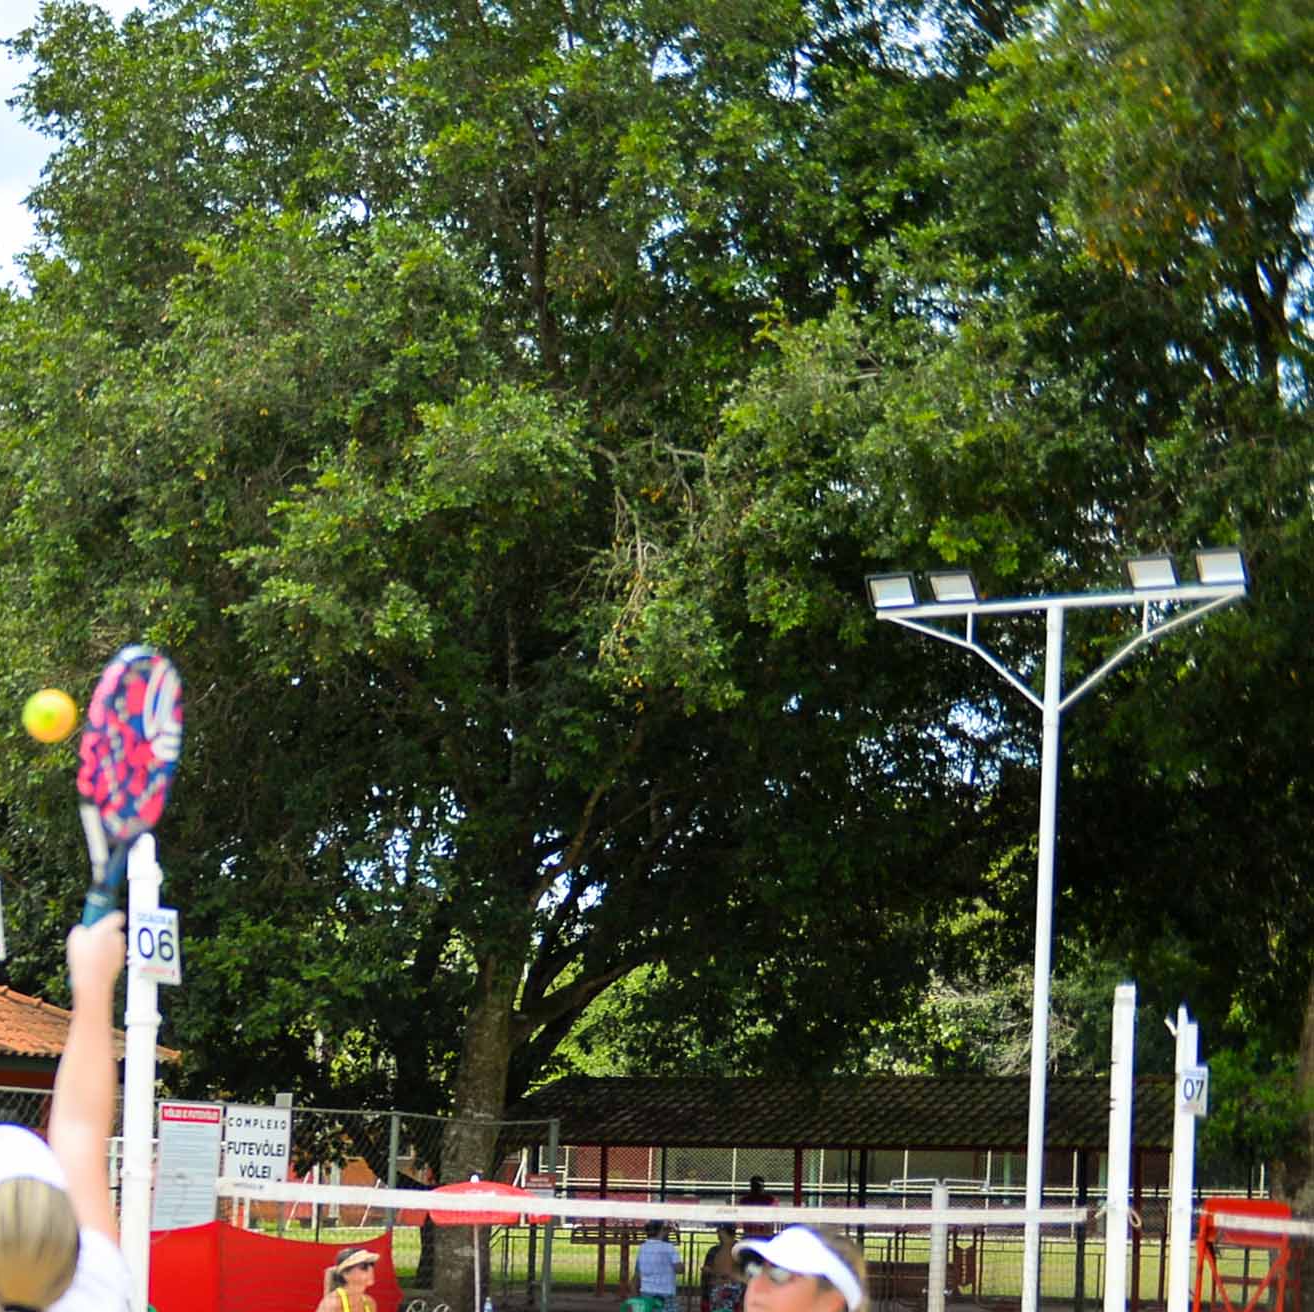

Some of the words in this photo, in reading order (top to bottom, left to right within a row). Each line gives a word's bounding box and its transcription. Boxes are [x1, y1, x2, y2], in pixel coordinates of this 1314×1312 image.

[138, 927, 174, 962] 06
[1183, 1078, 1205, 1102] 07
[228, 1117, 287, 1130] COMPLEXO
